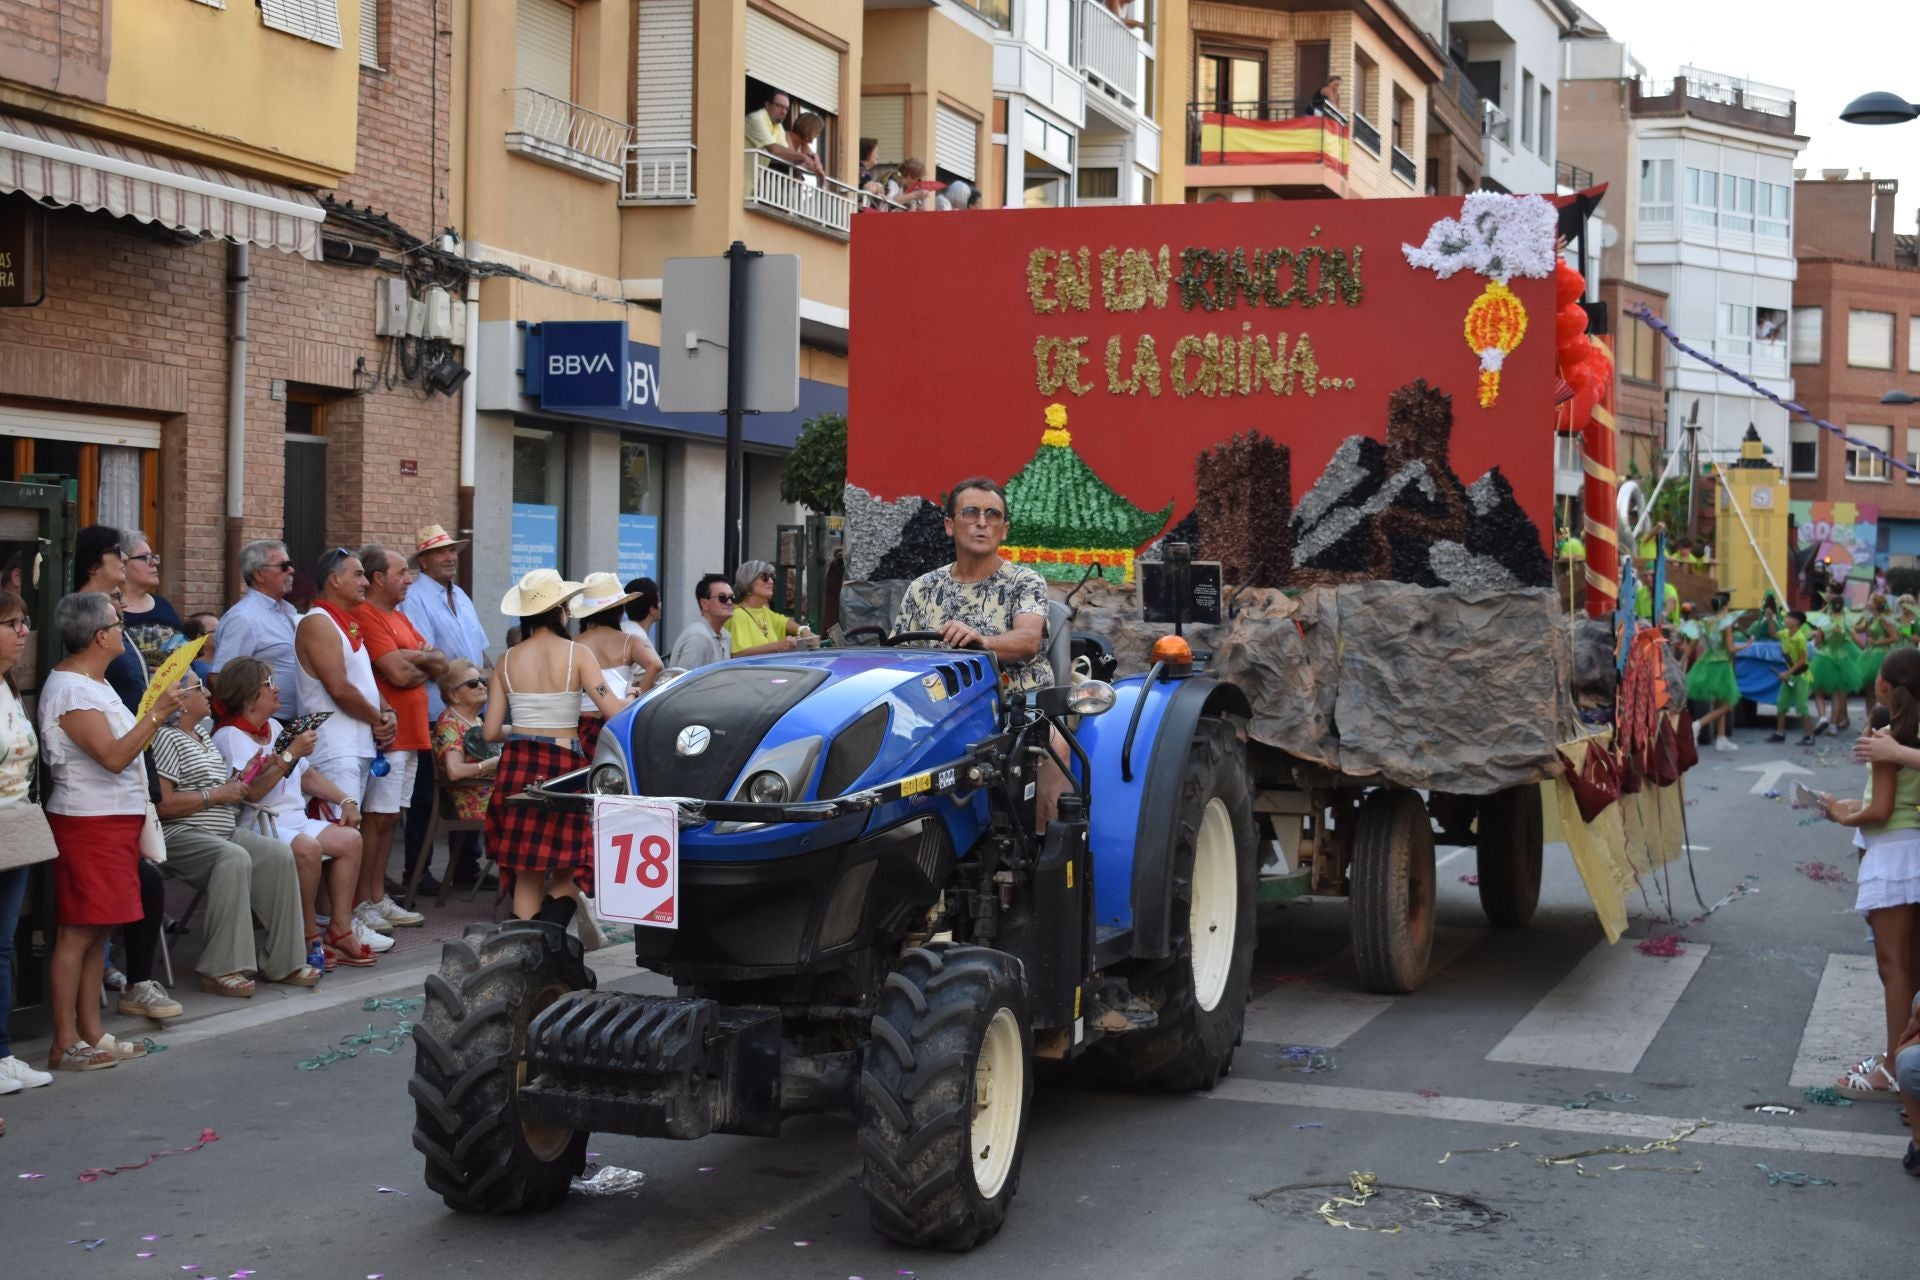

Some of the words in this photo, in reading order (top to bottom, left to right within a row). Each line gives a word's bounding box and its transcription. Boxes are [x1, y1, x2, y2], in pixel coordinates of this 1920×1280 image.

[1027, 246, 1092, 313] EN
[1099, 245, 1171, 312] UN
[1175, 225, 1364, 312] RINCÓN
[549, 353, 615, 375] BBVA
[1033, 335, 1094, 397] DE
[1105, 334, 1161, 397] LA
[611, 833, 671, 888] 18
